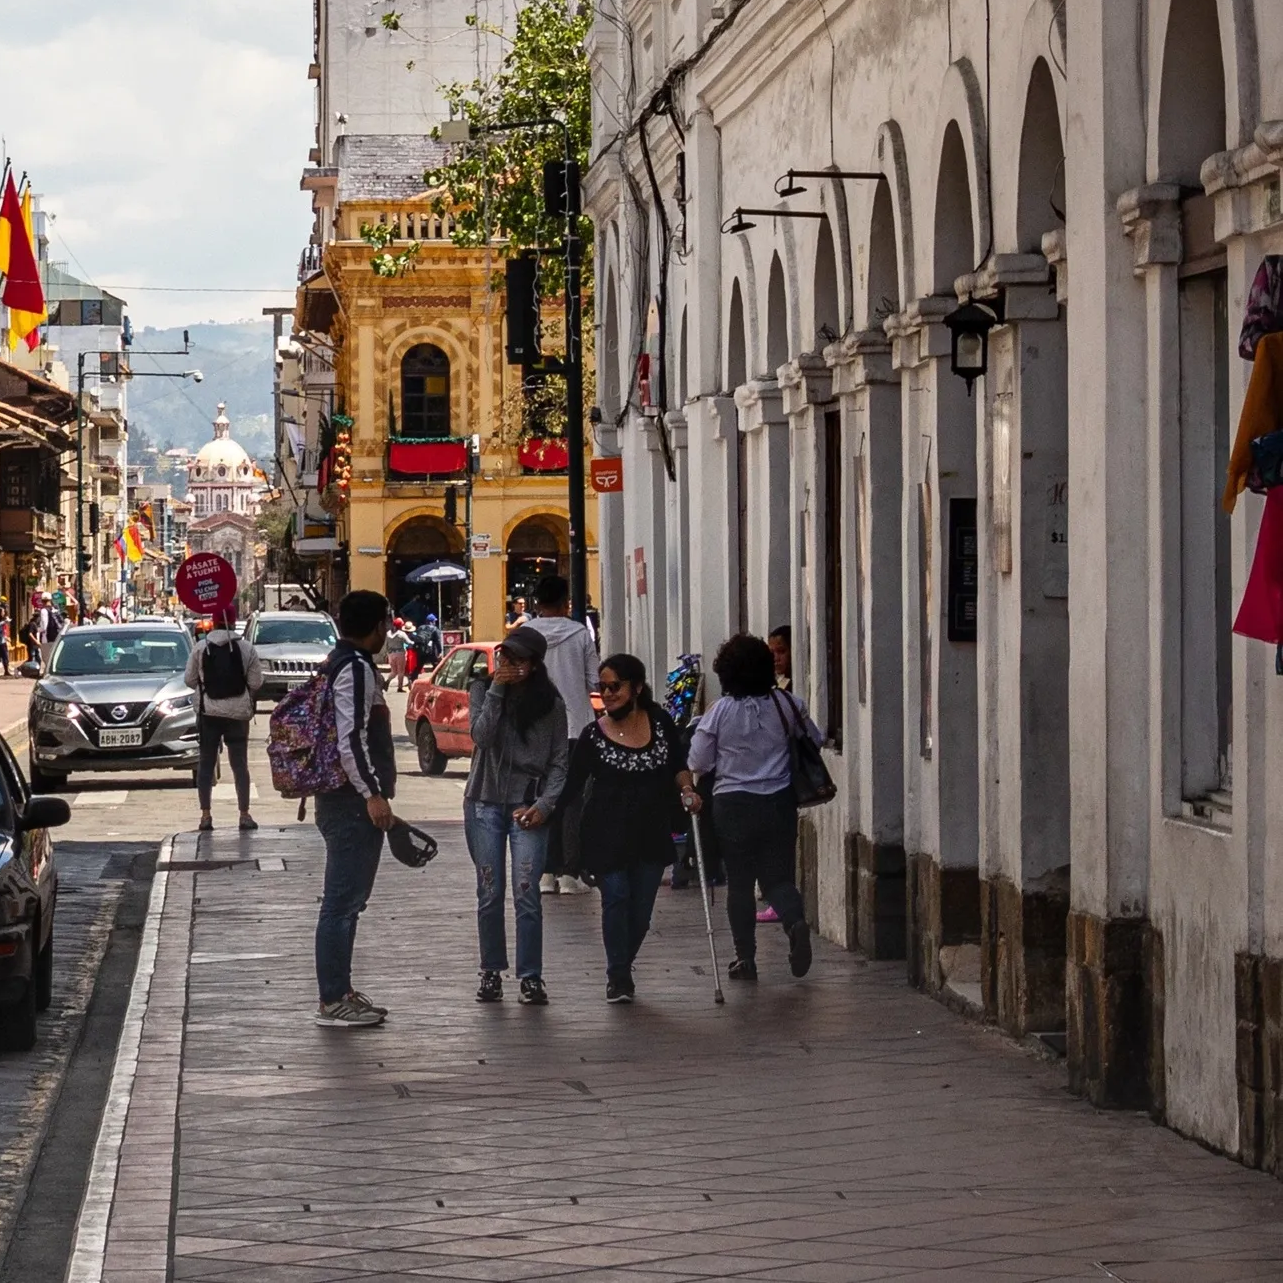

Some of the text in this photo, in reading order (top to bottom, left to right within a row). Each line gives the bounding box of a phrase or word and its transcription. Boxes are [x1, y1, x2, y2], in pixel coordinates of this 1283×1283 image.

[185, 558, 219, 573] PÁSATE
[193, 565, 221, 578] TUENTI
[100, 734, 141, 745] ABH-2087
